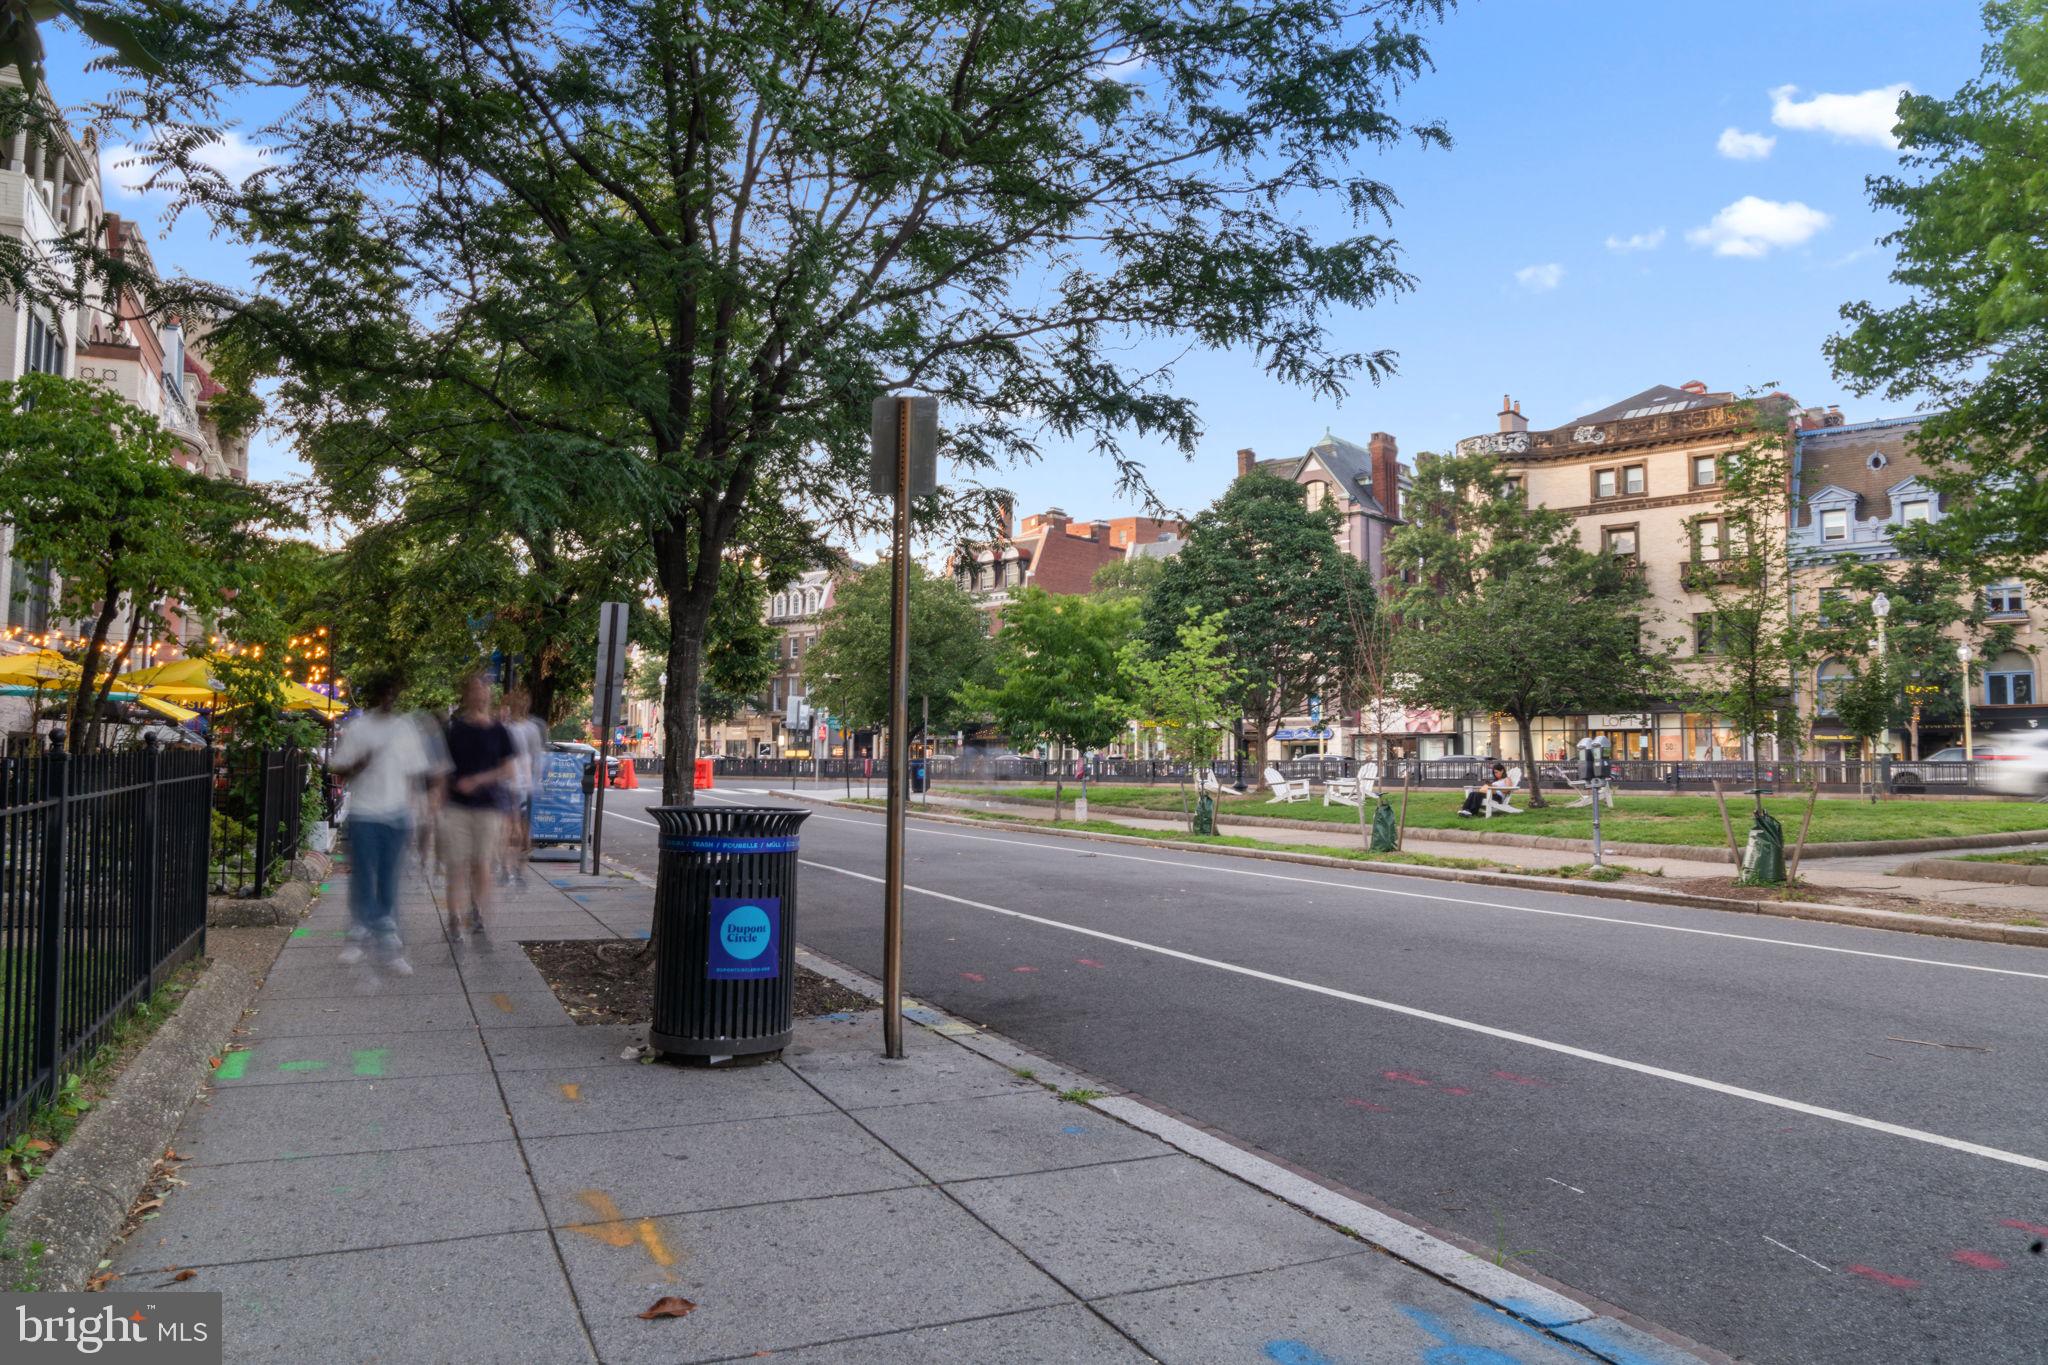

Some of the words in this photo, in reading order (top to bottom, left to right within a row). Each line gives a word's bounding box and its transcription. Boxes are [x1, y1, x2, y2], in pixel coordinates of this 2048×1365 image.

[692, 841, 714, 849] TRASH
[727, 923, 767, 936] Dupont
[727, 933, 758, 943] Circle
